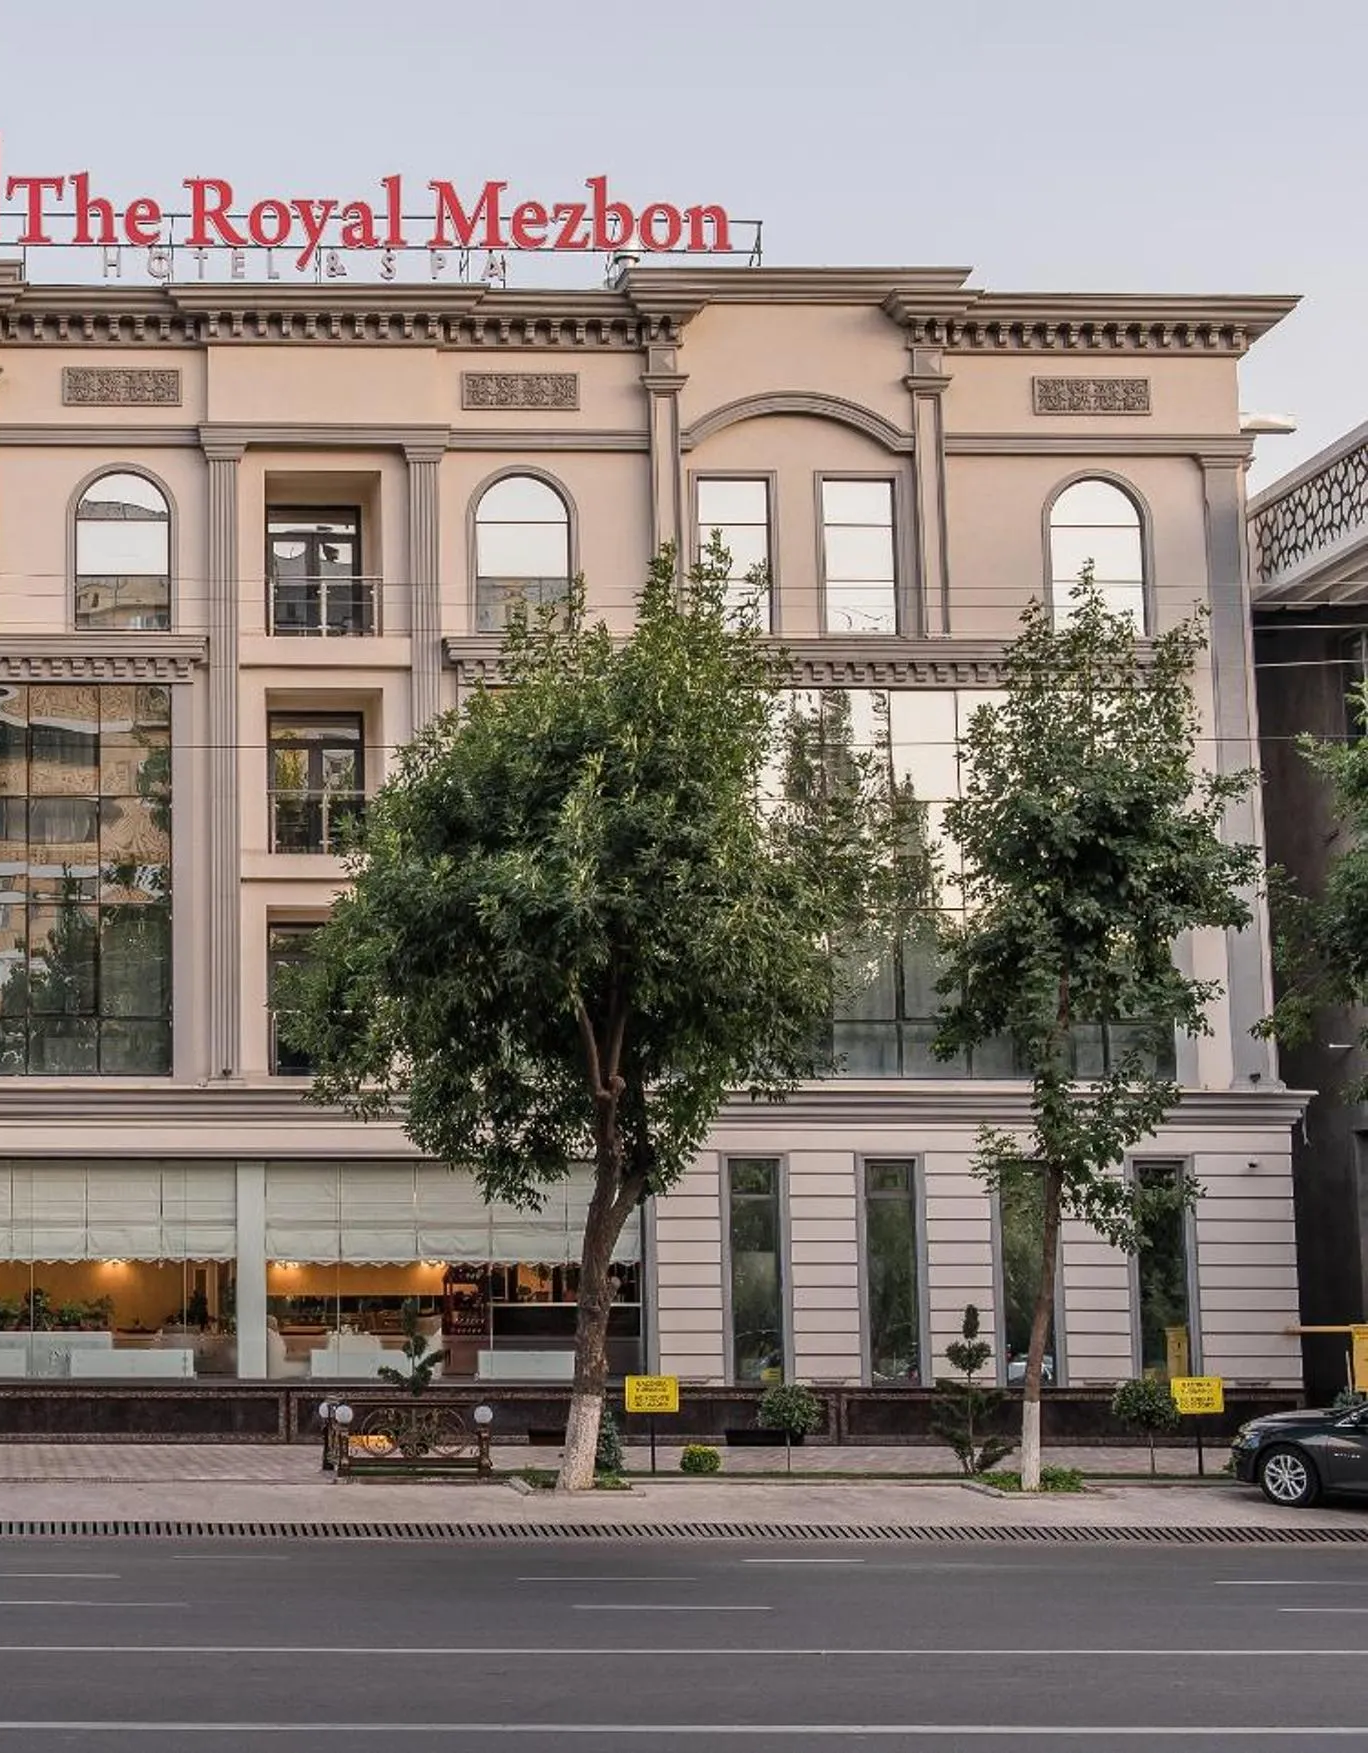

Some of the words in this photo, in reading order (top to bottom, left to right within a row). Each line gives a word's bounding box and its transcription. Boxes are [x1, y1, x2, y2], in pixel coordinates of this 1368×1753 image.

[5, 169, 162, 246] The
[183, 173, 407, 272] Royal
[427, 175, 732, 251] Mezbon
[103, 247, 281, 280] HOTEL
[325, 251, 348, 279] &
[380, 250, 505, 282] SPA
